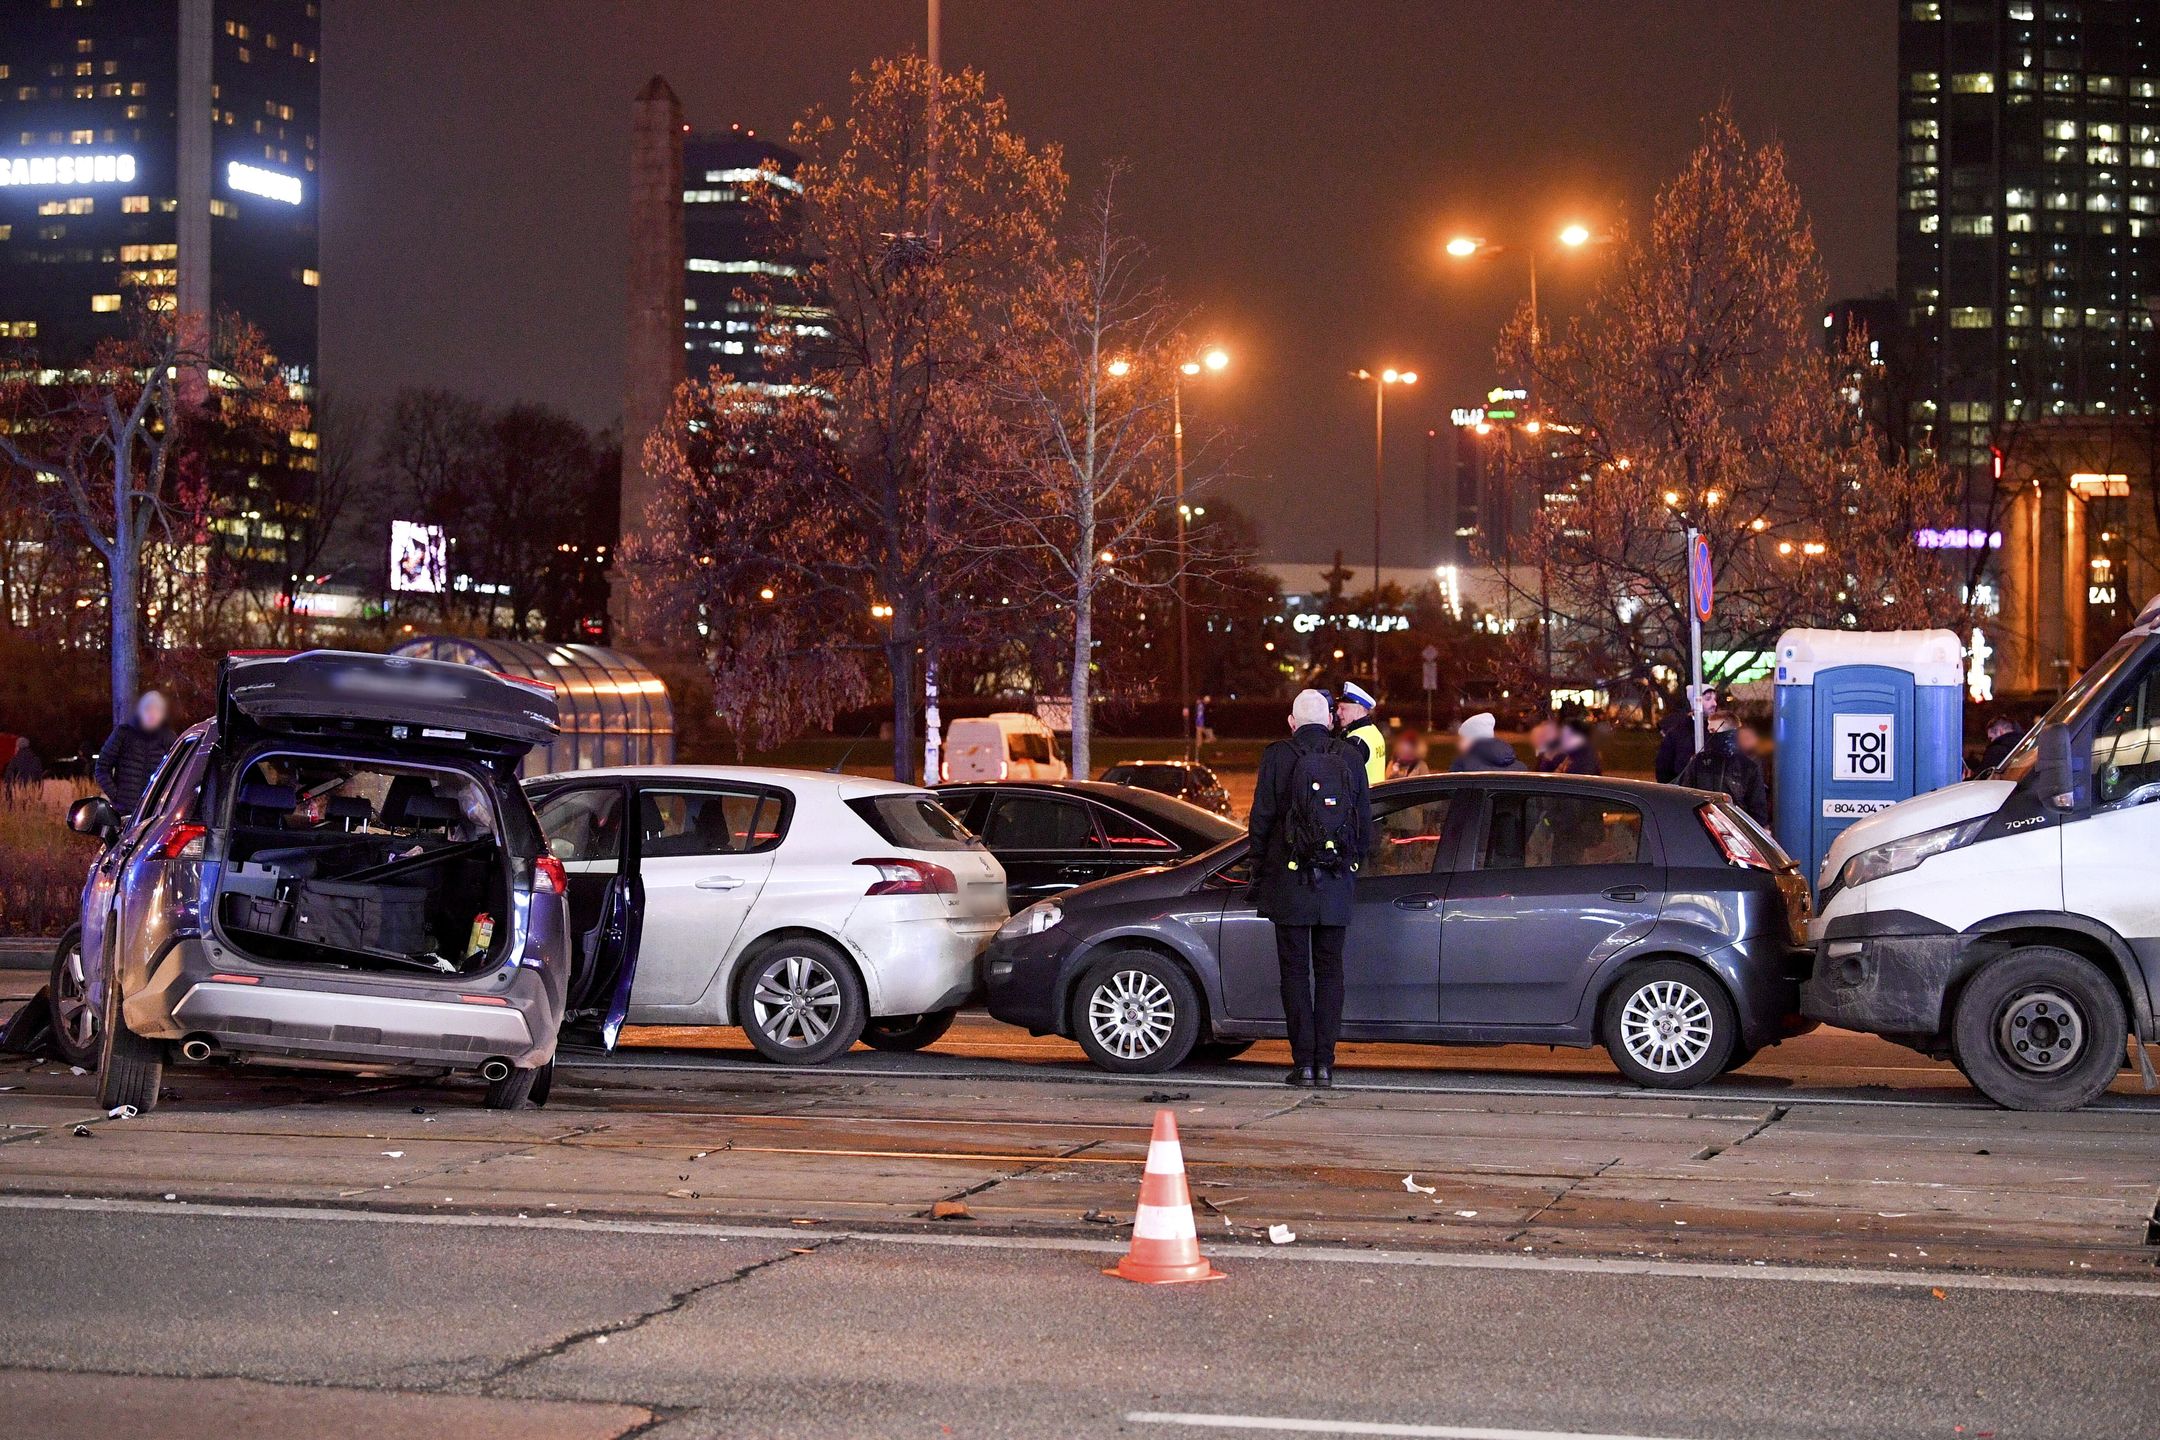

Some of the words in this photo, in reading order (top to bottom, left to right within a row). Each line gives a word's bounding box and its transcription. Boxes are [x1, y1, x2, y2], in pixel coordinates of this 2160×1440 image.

[0, 154, 136, 186] SAMSUNG
[1847, 732, 1886, 753] TOI
[1847, 753, 1886, 774] TOI
[1834, 803, 1855, 813] 804
[1857, 803, 1877, 813] 204
[2005, 816, 2046, 829] 70-170
